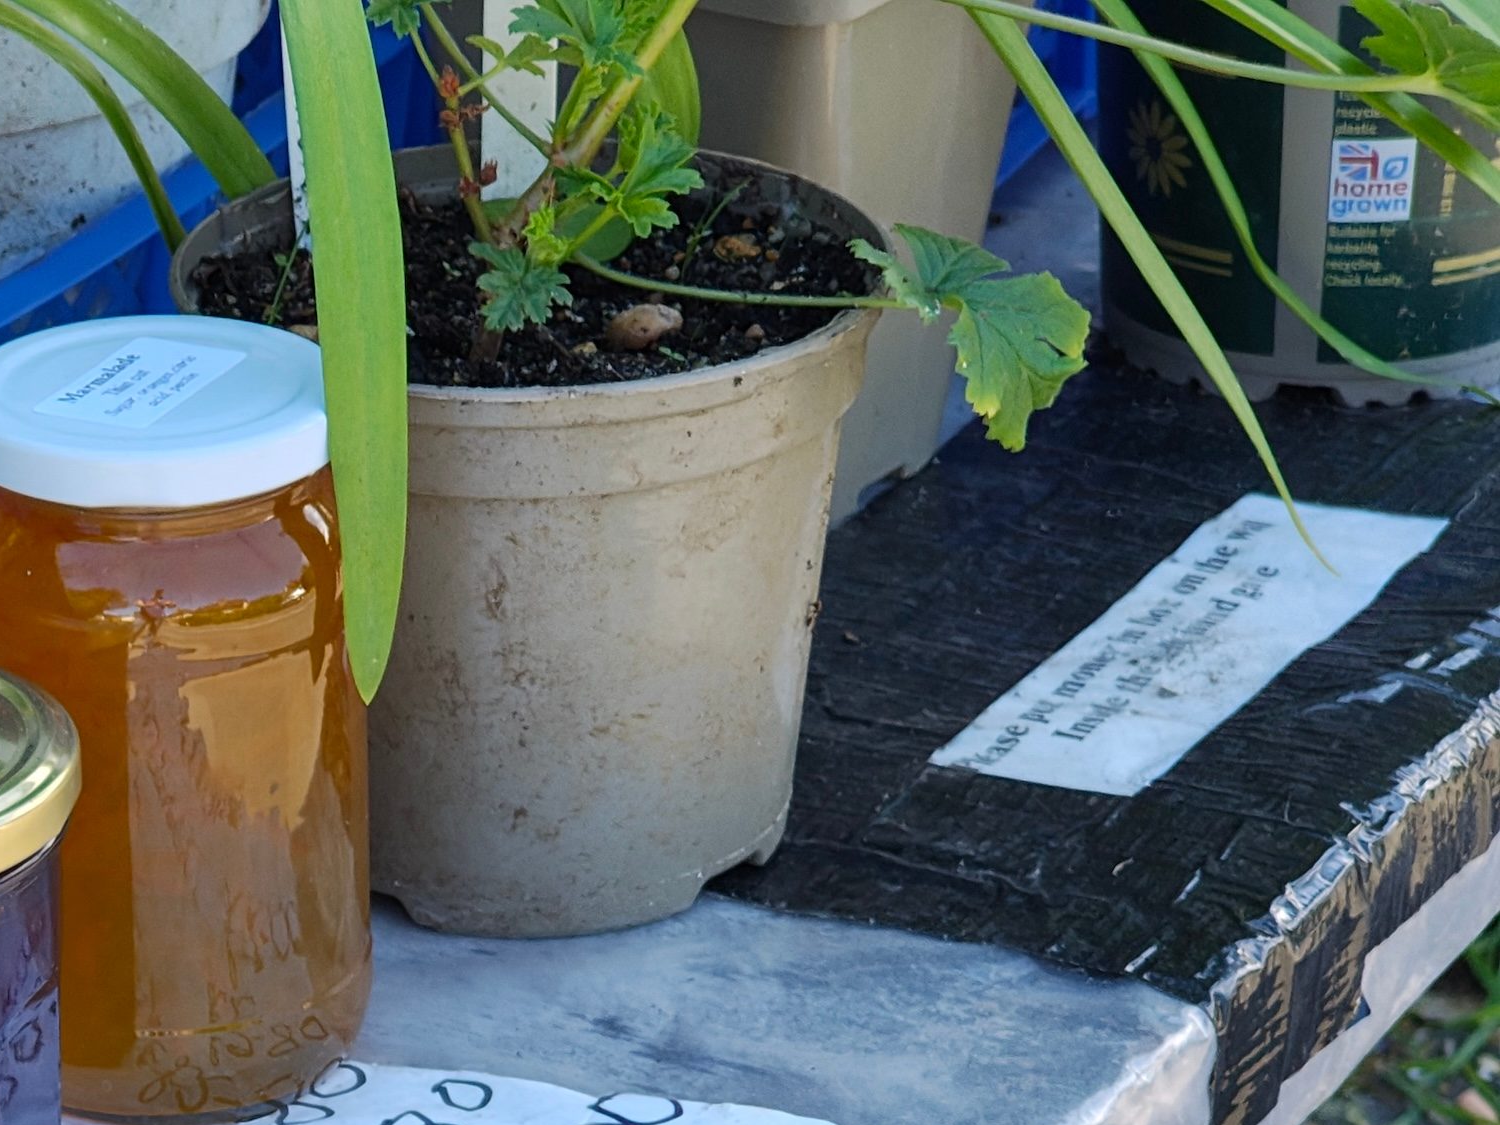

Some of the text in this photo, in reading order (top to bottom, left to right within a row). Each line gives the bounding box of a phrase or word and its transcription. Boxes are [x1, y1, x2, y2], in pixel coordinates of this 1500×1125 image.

[1334, 178, 1408, 197] home
[1331, 198, 1407, 217] grown
[57, 354, 141, 403] Marmalade
